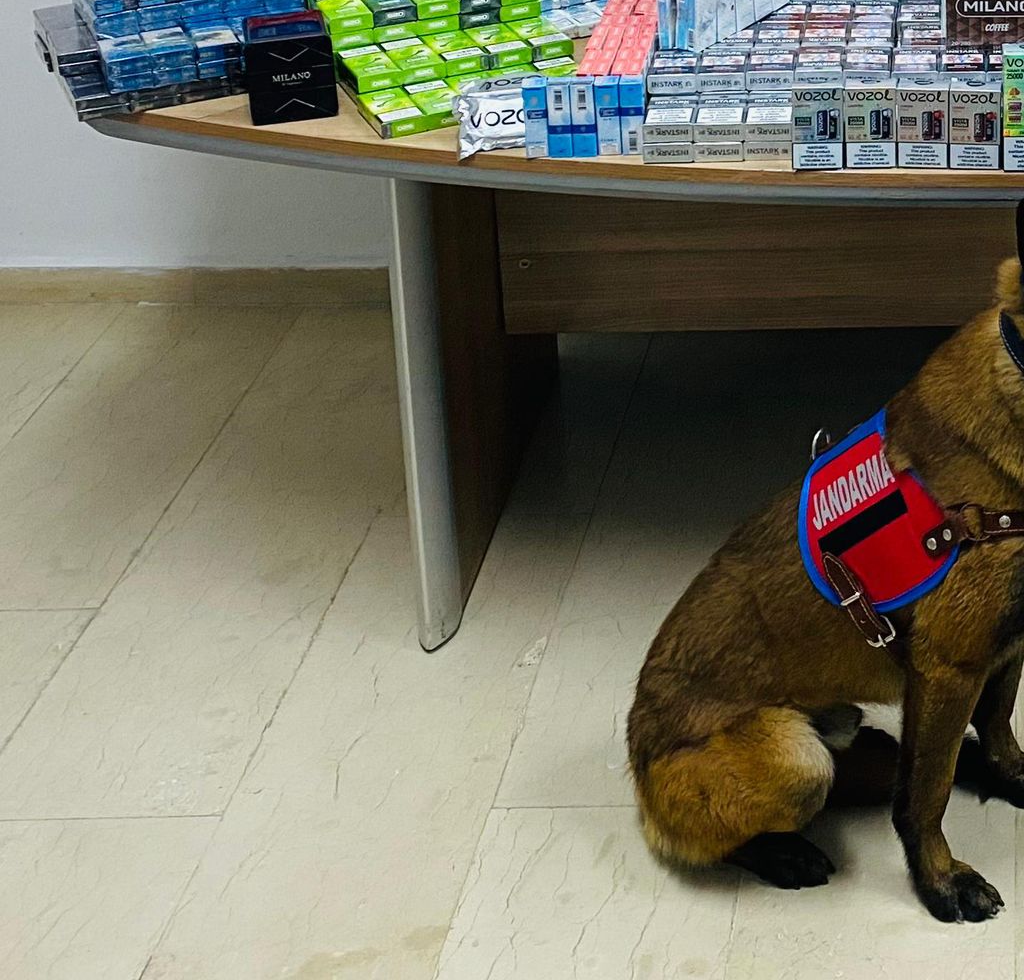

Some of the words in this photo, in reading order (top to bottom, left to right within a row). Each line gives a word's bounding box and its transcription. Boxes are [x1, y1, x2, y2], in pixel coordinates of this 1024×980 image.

[985, 23, 1010, 32] COFFEE
[272, 71, 311, 83] MILANO
[750, 77, 782, 85] INSTARK
[651, 80, 684, 88] INSTARK
[700, 79, 732, 87] INSTARK
[794, 88, 841, 101] VOZOL
[847, 89, 894, 101] VOZOL
[899, 90, 945, 103] VOZOL
[951, 92, 998, 104] VOZOL
[655, 128, 689, 136] INSTARK
[706, 128, 740, 136] INSTARK
[756, 127, 790, 135] INSTARK
[706, 148, 740, 156] INSTARK
[747, 147, 778, 156] INSTARK
[812, 450, 896, 531] JANDARMA
